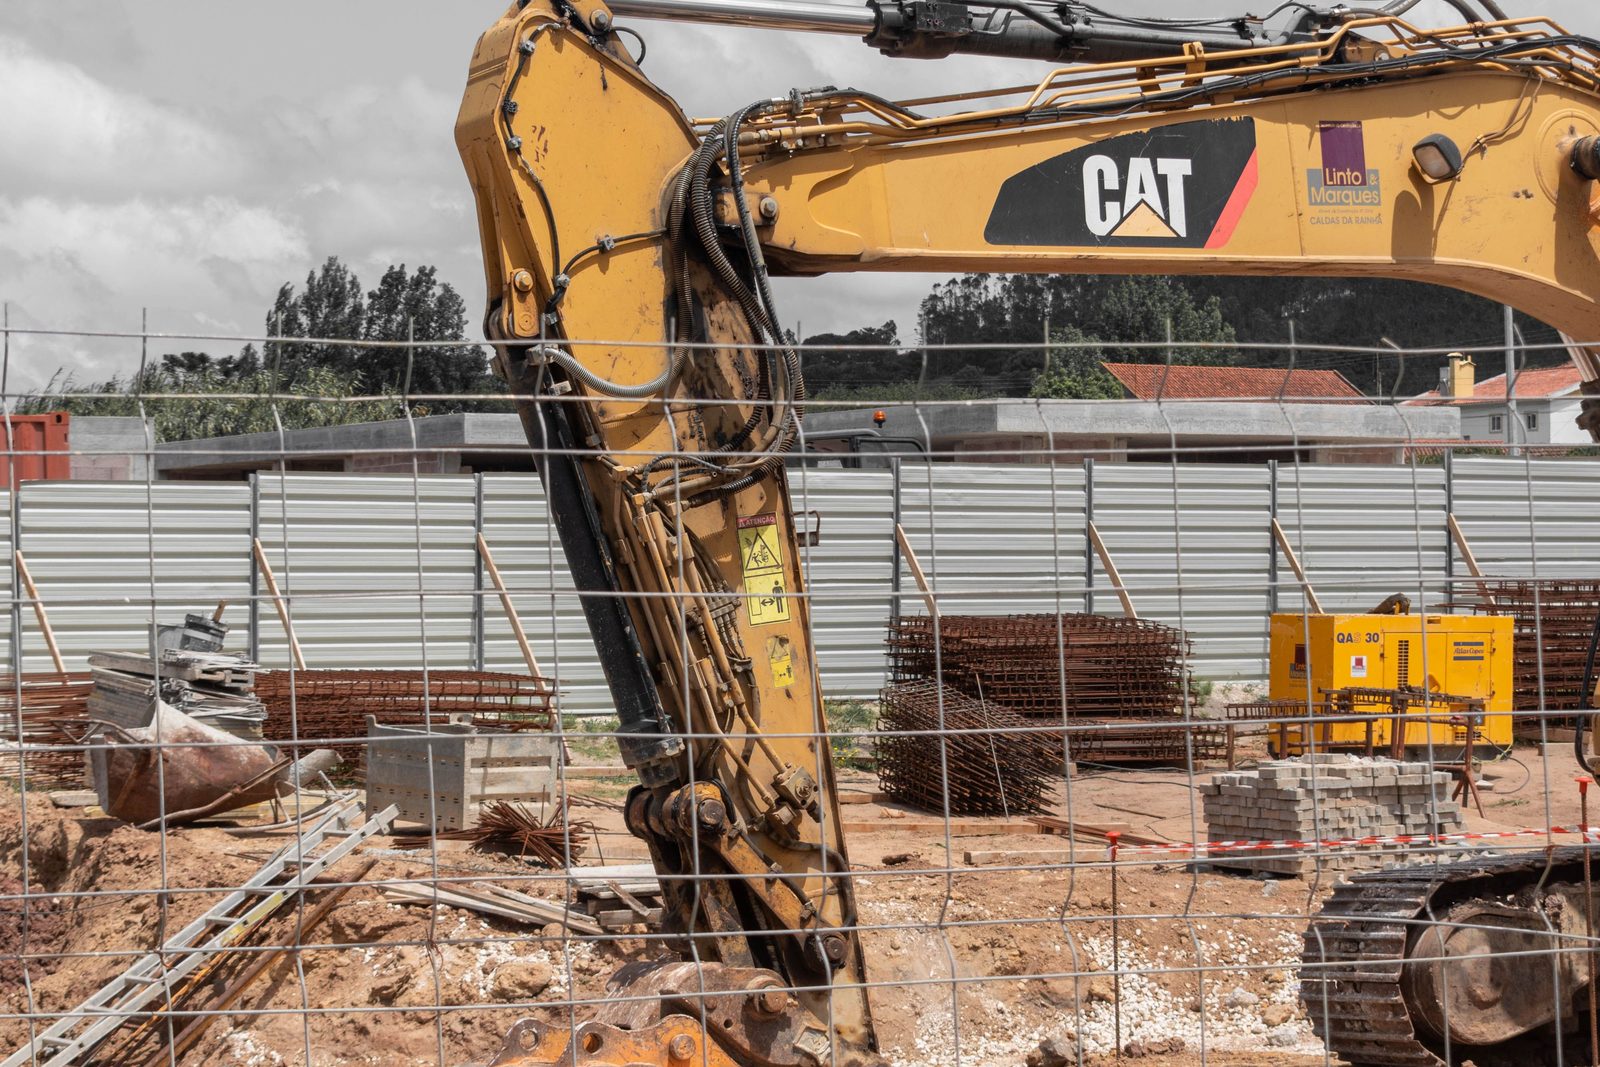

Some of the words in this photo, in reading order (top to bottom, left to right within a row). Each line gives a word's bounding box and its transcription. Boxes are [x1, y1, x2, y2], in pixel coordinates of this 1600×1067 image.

[1325, 168, 1362, 185] Linto
[1369, 174, 1378, 185] &
[1082, 154, 1193, 238] CAT
[1311, 187, 1379, 205] Marques
[1310, 217, 1340, 225] CALDAS
[1341, 216, 1353, 225] DA
[1354, 216, 1383, 225] RAINHA
[1365, 632, 1380, 643] 30
